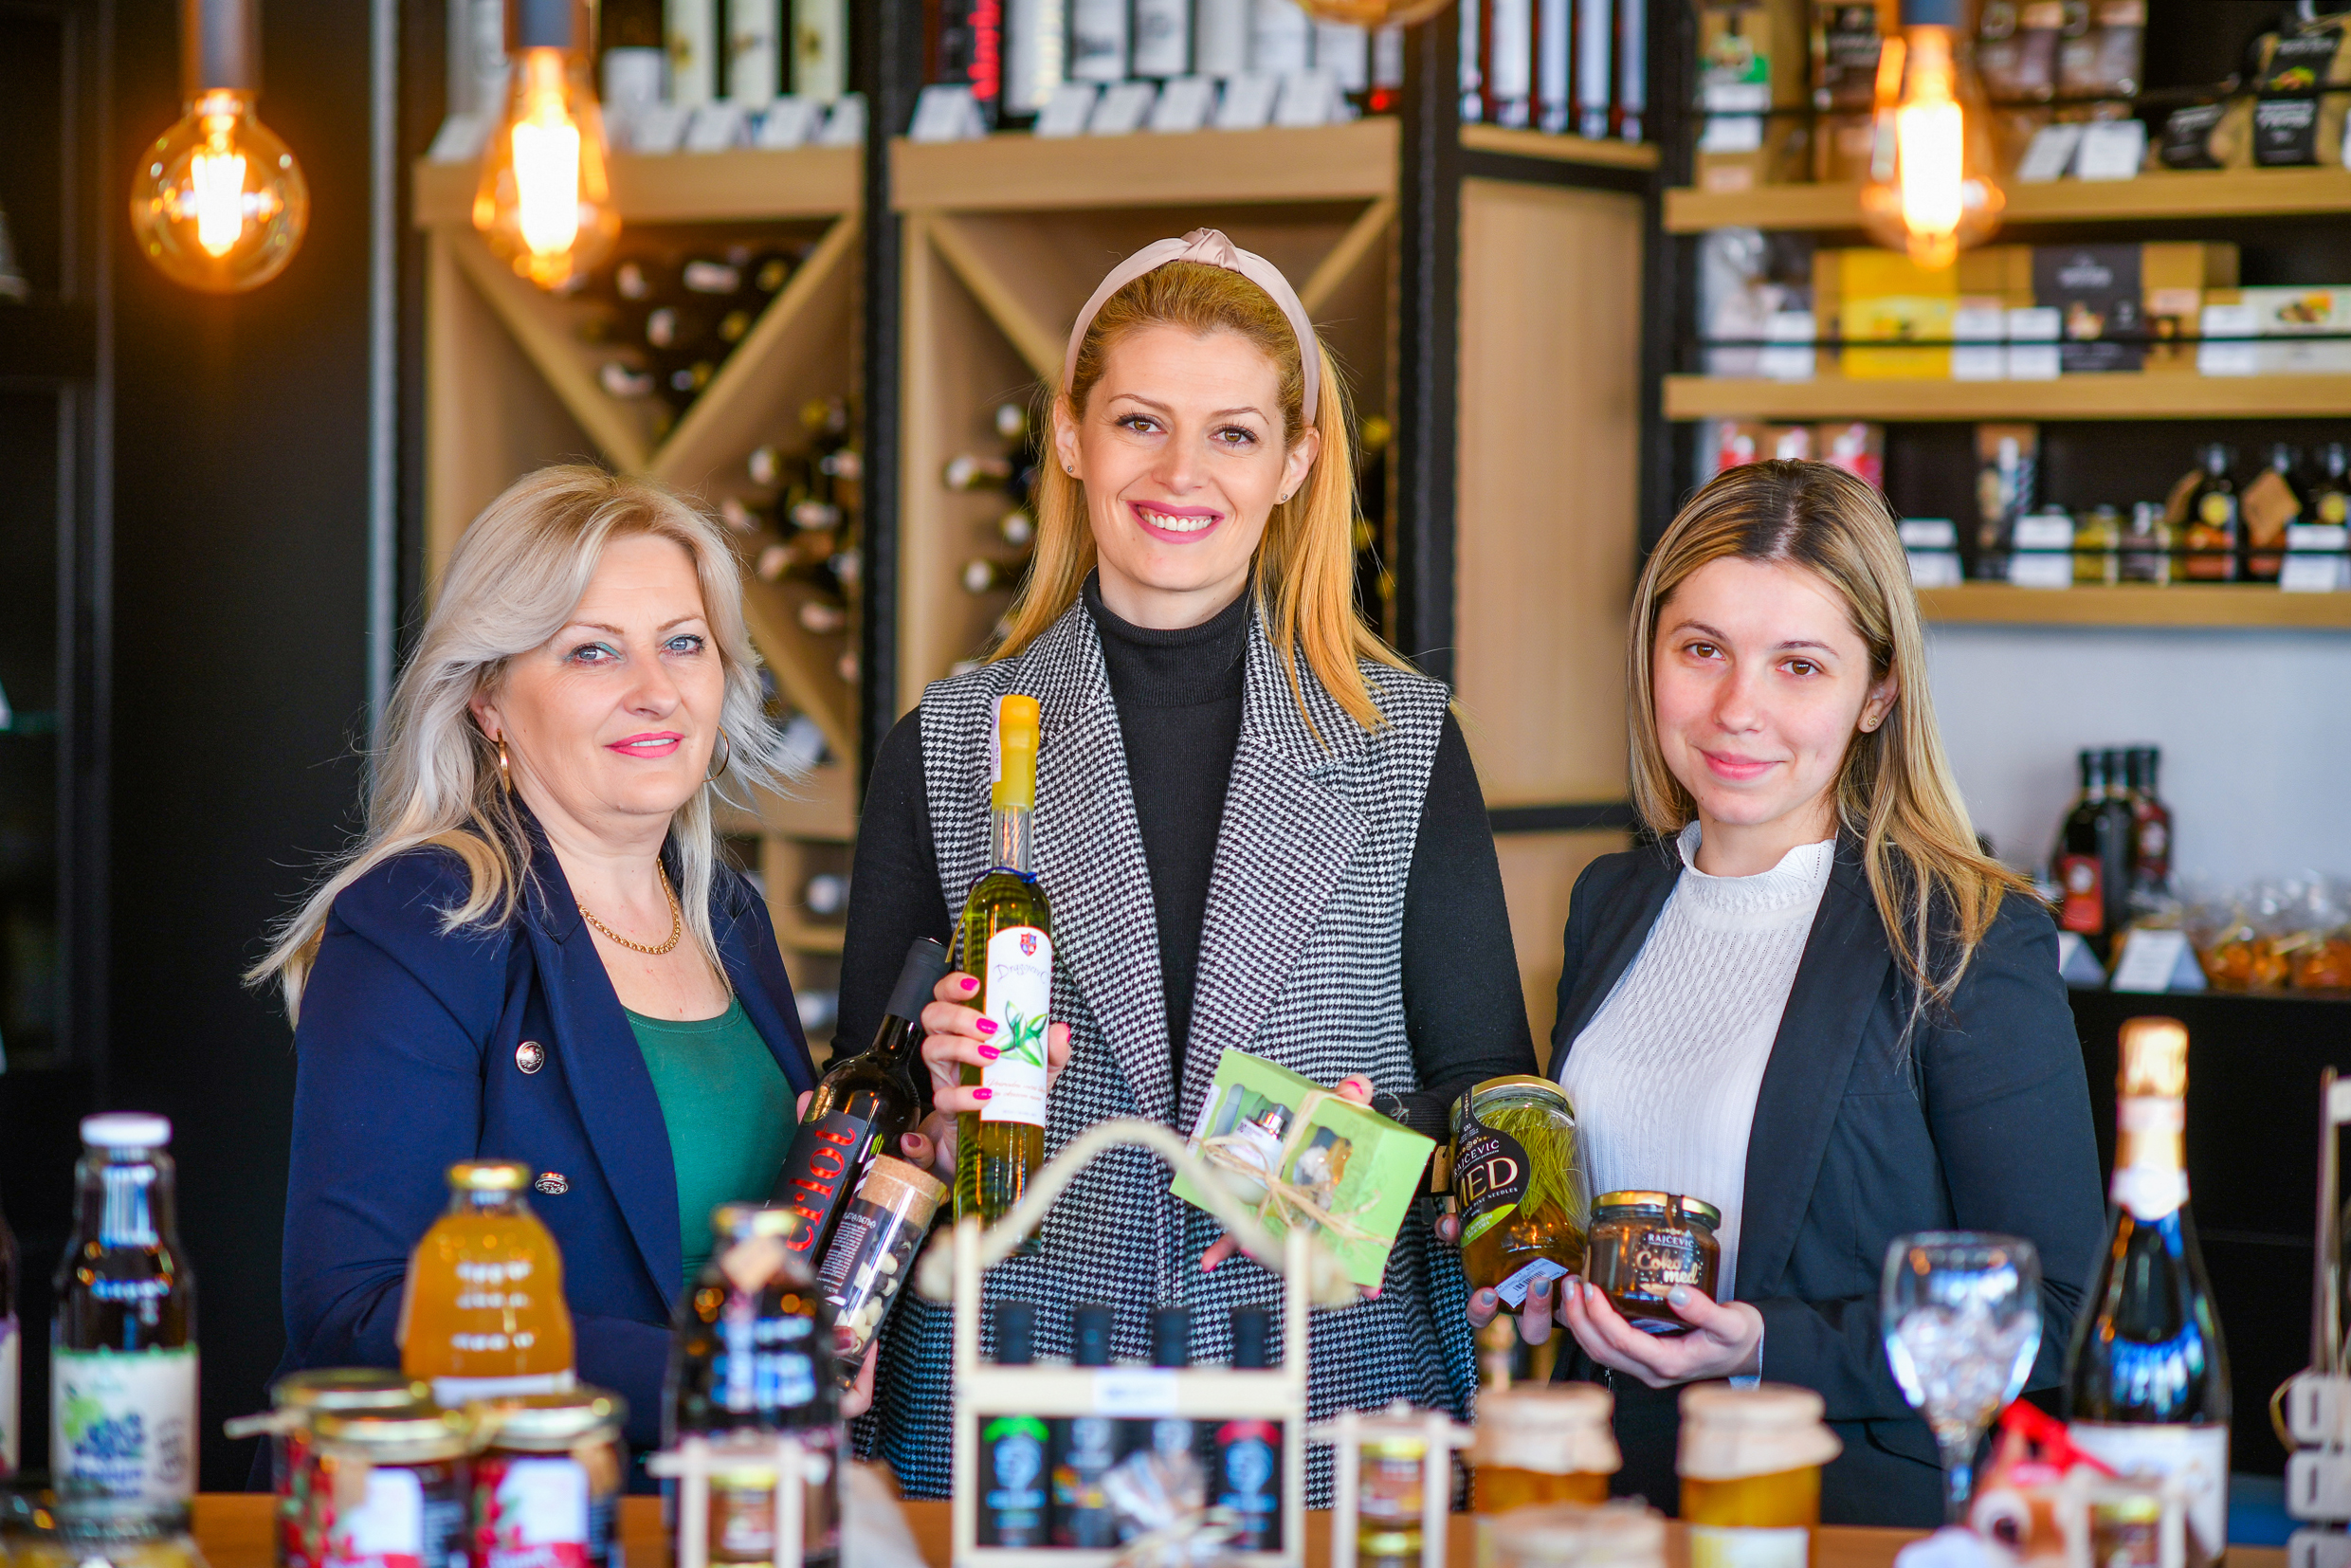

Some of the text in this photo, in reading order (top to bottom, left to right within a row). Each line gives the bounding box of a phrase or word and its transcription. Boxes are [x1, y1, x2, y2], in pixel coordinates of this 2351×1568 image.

[786, 1123, 857, 1260] erlot
[1455, 1158, 1518, 1212] MED
[1487, 1187, 1519, 1199] NEEDLES
[1635, 1244, 1683, 1270] Čoko
[1663, 1262, 1699, 1285] med
